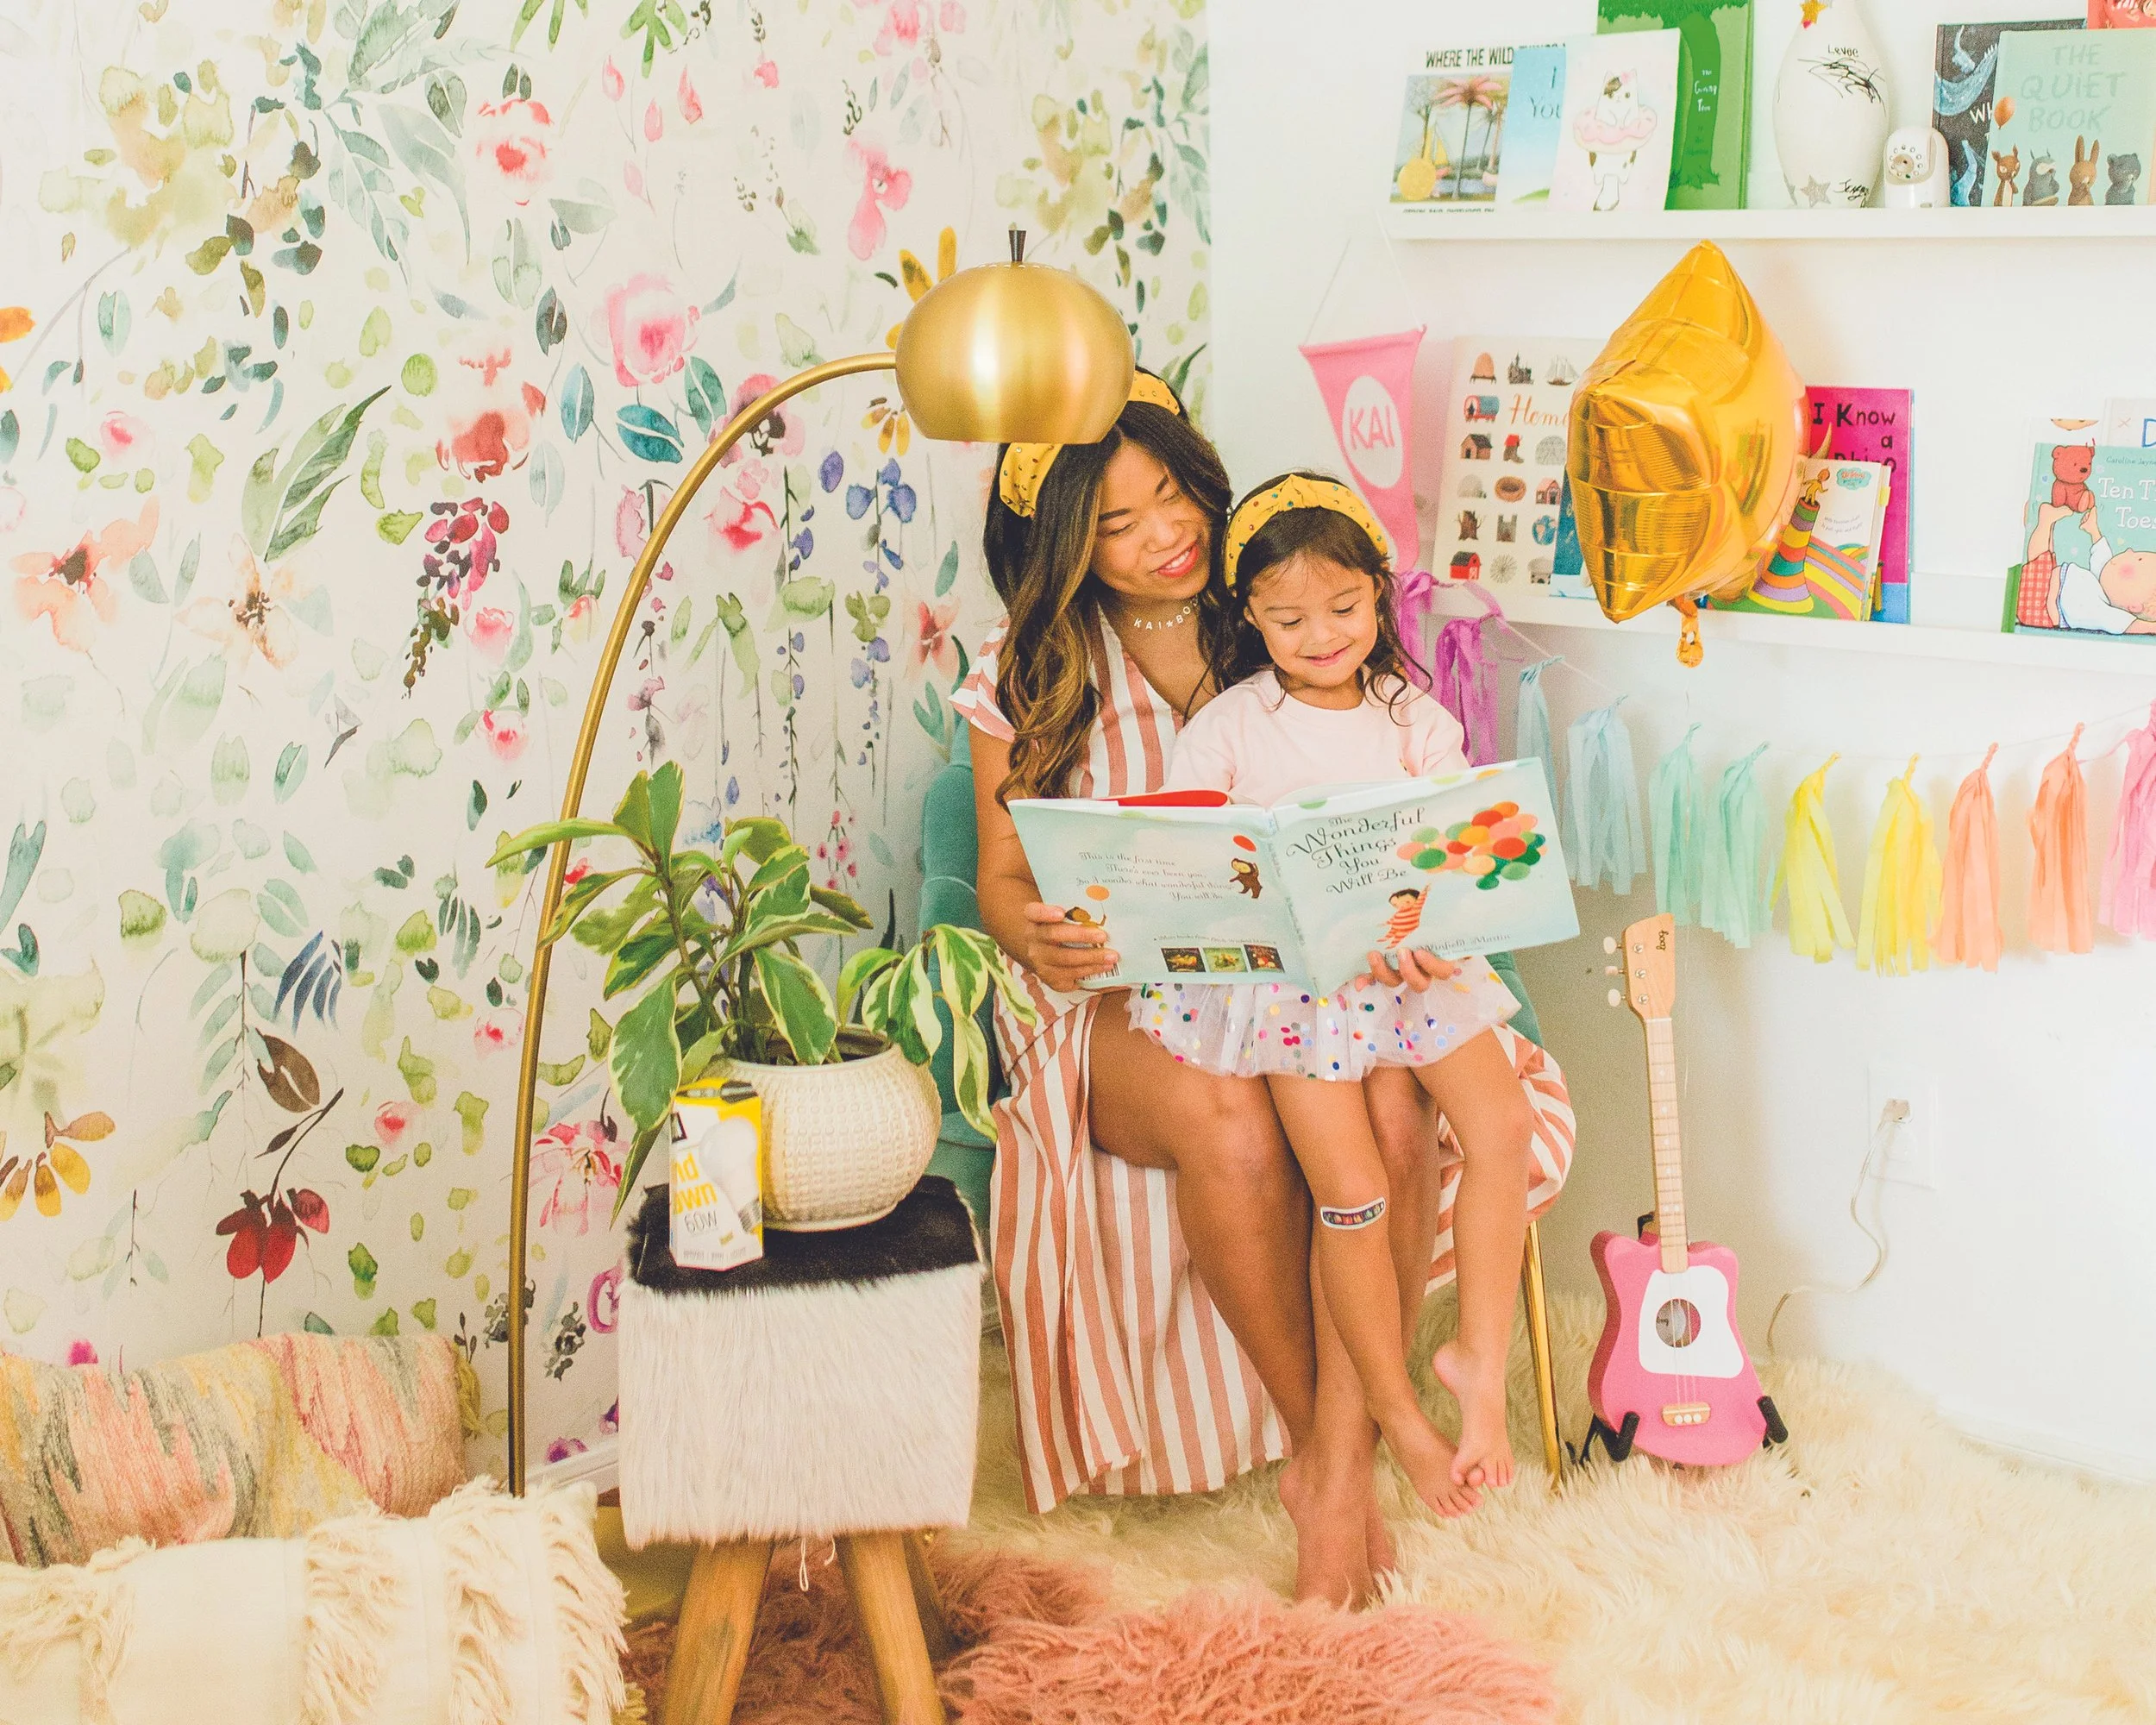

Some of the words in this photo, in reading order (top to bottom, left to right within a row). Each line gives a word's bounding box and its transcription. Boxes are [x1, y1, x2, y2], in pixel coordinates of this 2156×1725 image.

[1426, 49, 1463, 68] WHERE
[1466, 47, 1484, 66] THE
[1489, 47, 1514, 65] WILD
[2053, 43, 2103, 66] THE
[2028, 105, 2112, 133] BOOK
[1349, 404, 1395, 450] KAI
[1813, 403, 1825, 425] I
[1837, 403, 1896, 427] Know
[1881, 436, 1893, 448] a
[2098, 477, 2134, 499] Ten
[2115, 505, 2156, 530] Toe
[1133, 617, 1162, 630] KAI
[1286, 807, 1426, 857] Wonderful
[1328, 816, 1353, 827] The
[1311, 837, 1397, 869] Things
[1338, 856, 1380, 875] You
[1326, 873, 1374, 894] Will
[1378, 868, 1407, 882] Be
[684, 1209, 718, 1234] 60W
